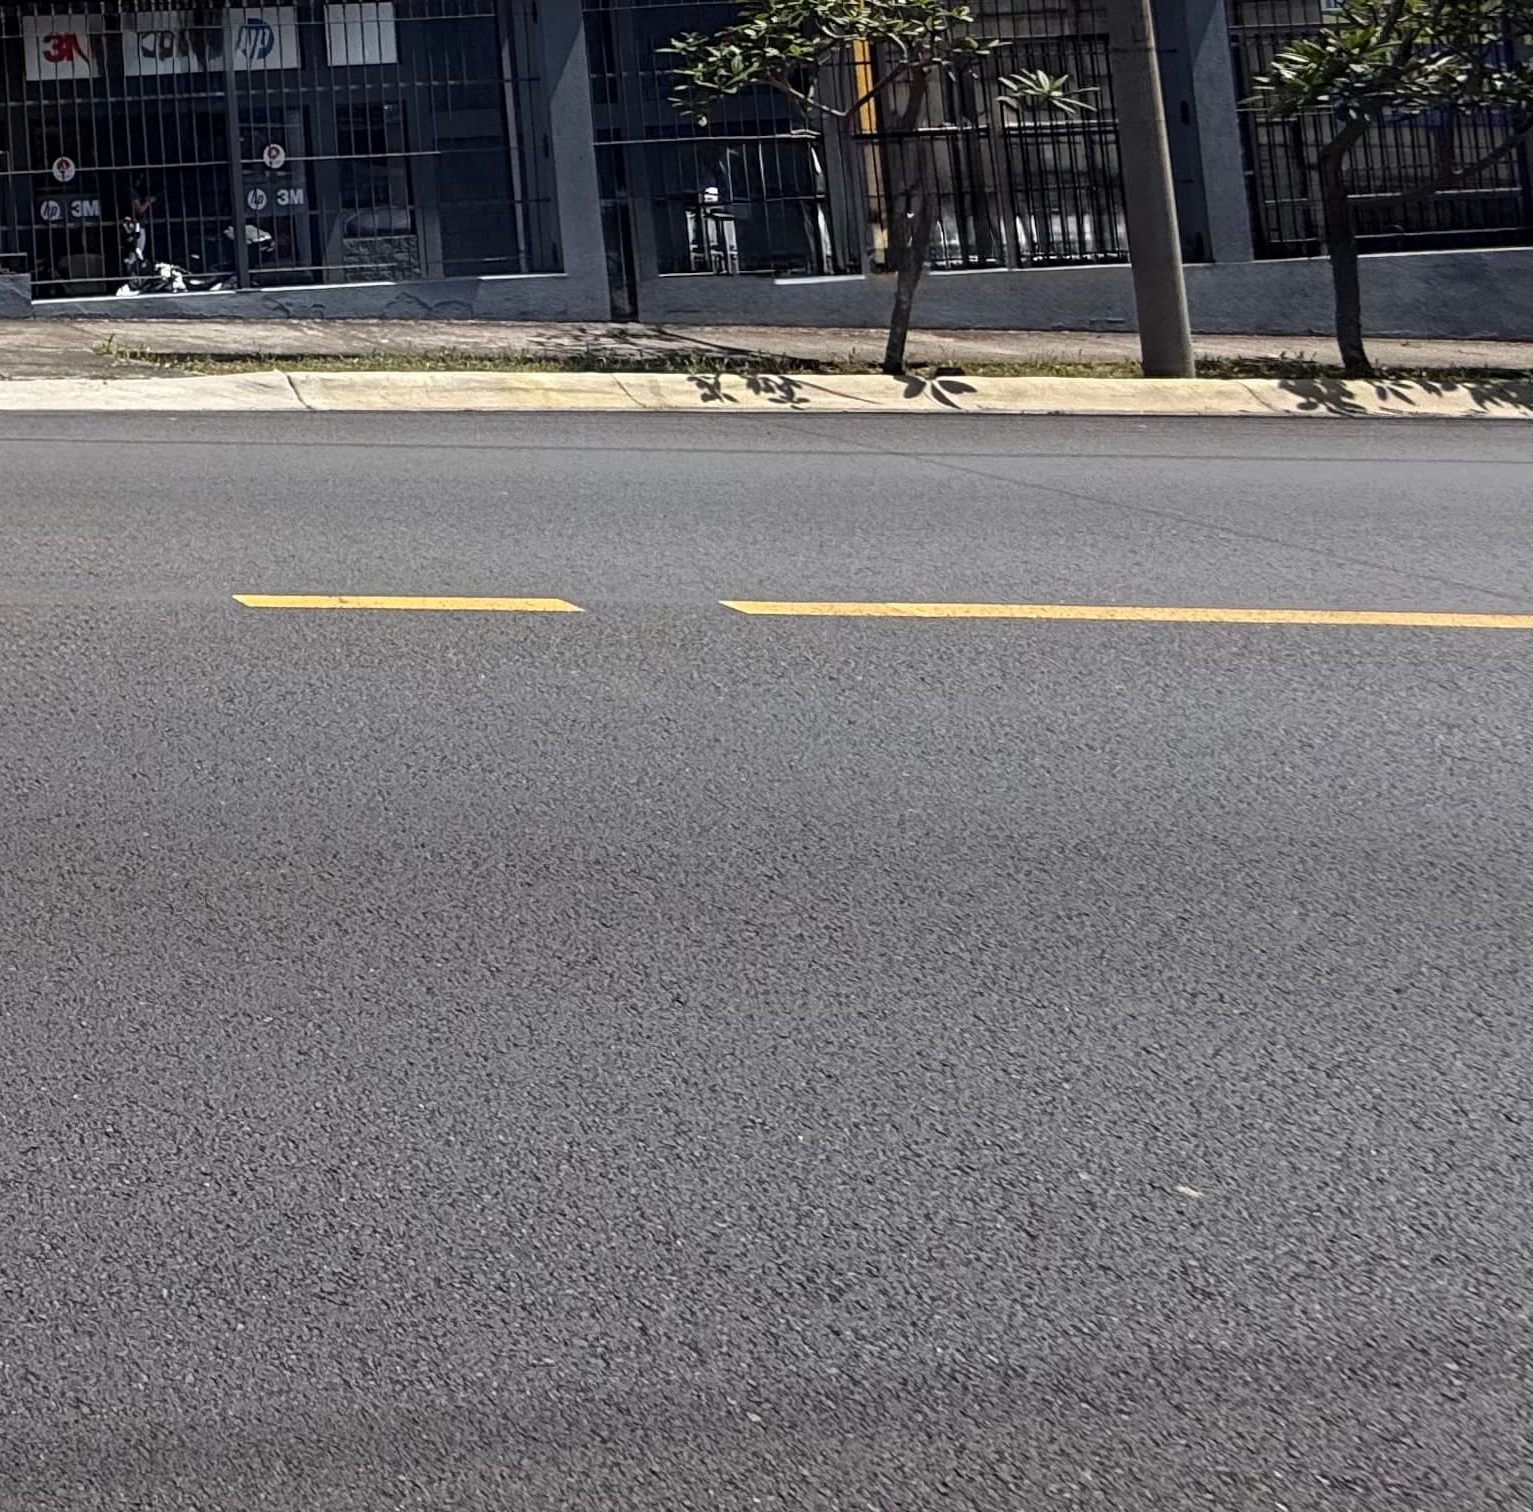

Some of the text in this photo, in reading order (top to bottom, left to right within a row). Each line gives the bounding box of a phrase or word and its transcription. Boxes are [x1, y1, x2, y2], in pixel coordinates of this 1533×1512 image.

[277, 189, 304, 205] 3M
[42, 200, 101, 220] hp 3M
